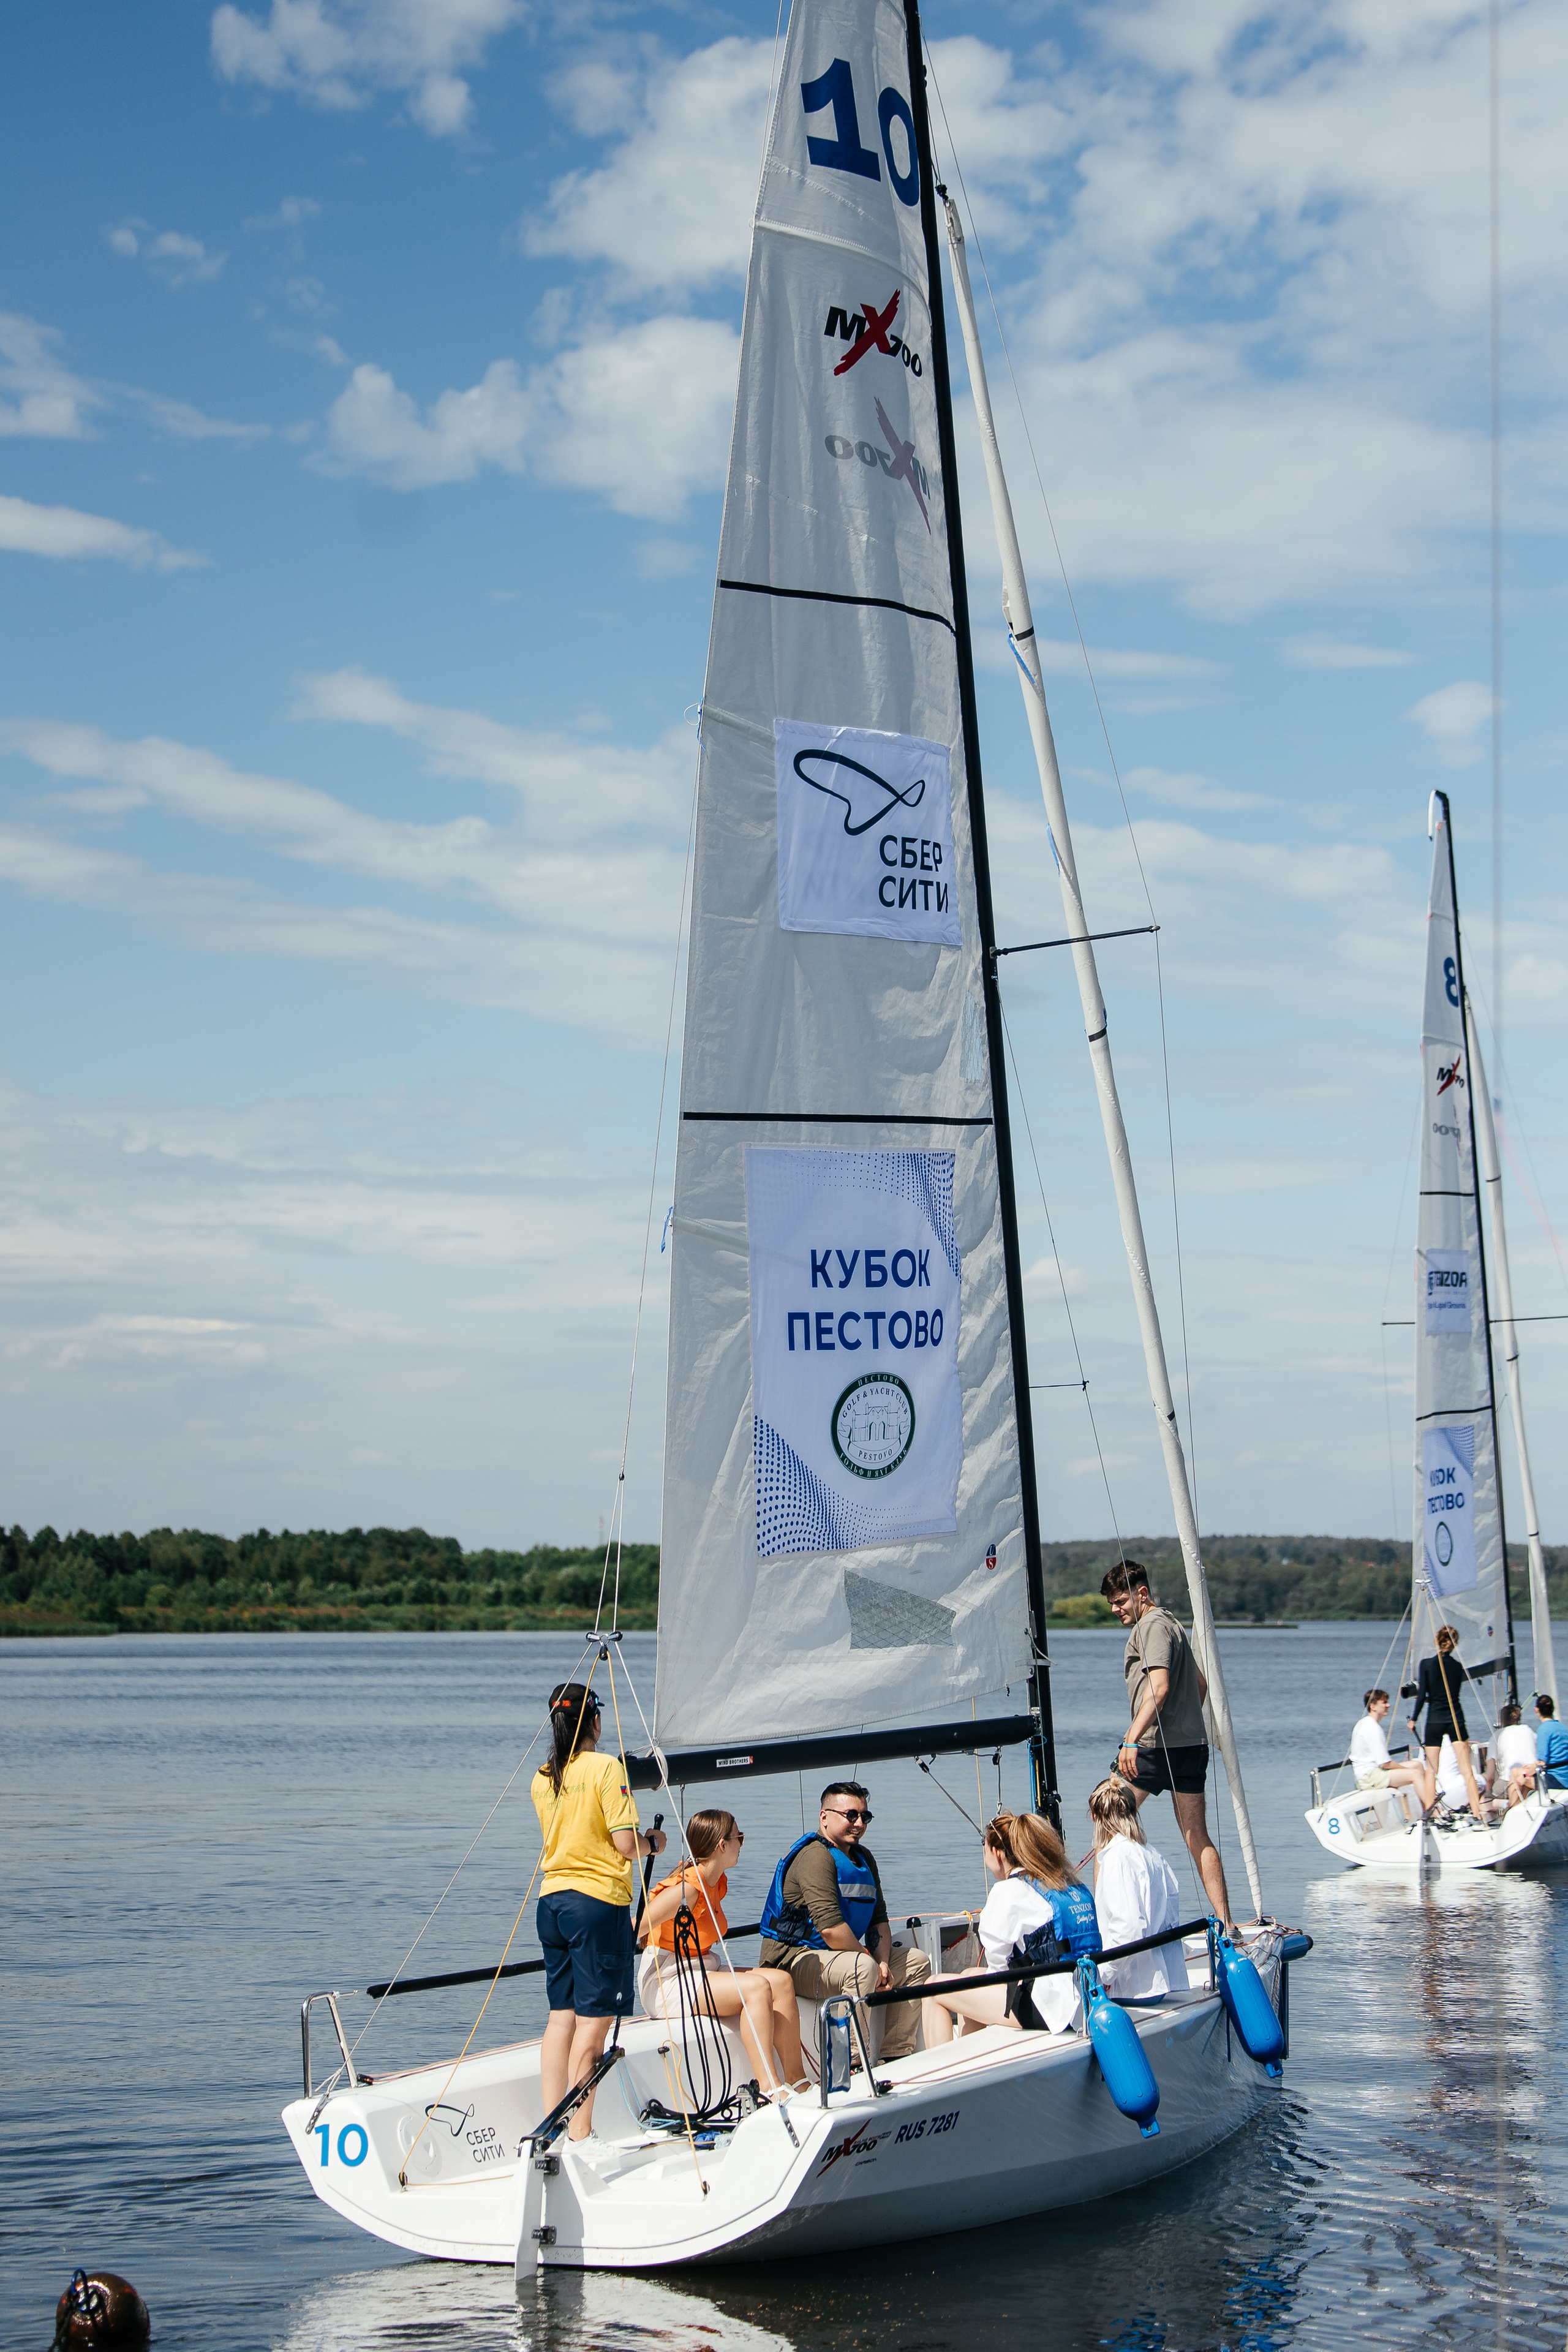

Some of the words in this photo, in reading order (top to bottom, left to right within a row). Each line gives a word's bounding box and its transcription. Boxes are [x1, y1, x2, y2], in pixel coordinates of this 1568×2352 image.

[801, 57, 920, 207] 10
[824, 288, 922, 378] MX700
[879, 834, 943, 872] СБЕР
[878, 875, 949, 914] СИТИ
[1443, 957, 1459, 1008] 8
[810, 1248, 931, 1289] КУБОК
[787, 1308, 944, 1351] ПЕСТОВО
[858, 1374, 899, 1387] ПЕСТОВО
[842, 1393, 861, 1419] GOLF
[870, 1387, 895, 1396] YACHT
[895, 1392, 908, 1415] CLUB
[840, 1452, 864, 1476] ГОЛЬФ
[875, 1467, 888, 1477] ЯХТ
[891, 1449, 908, 1471] КЛУБ
[858, 1449, 892, 1461] PESTOVO
[1328, 1817, 1340, 1834] 8
[1068, 1903, 1093, 1914] TENZOR
[466, 2127, 496, 2145] СБЕР
[894, 2119, 927, 2144] RUS
[926, 2111, 960, 2136] 7281
[314, 2124, 369, 2167] 10
[473, 2144, 505, 2163] СИТИ
[816, 2117, 878, 2179] MX700
